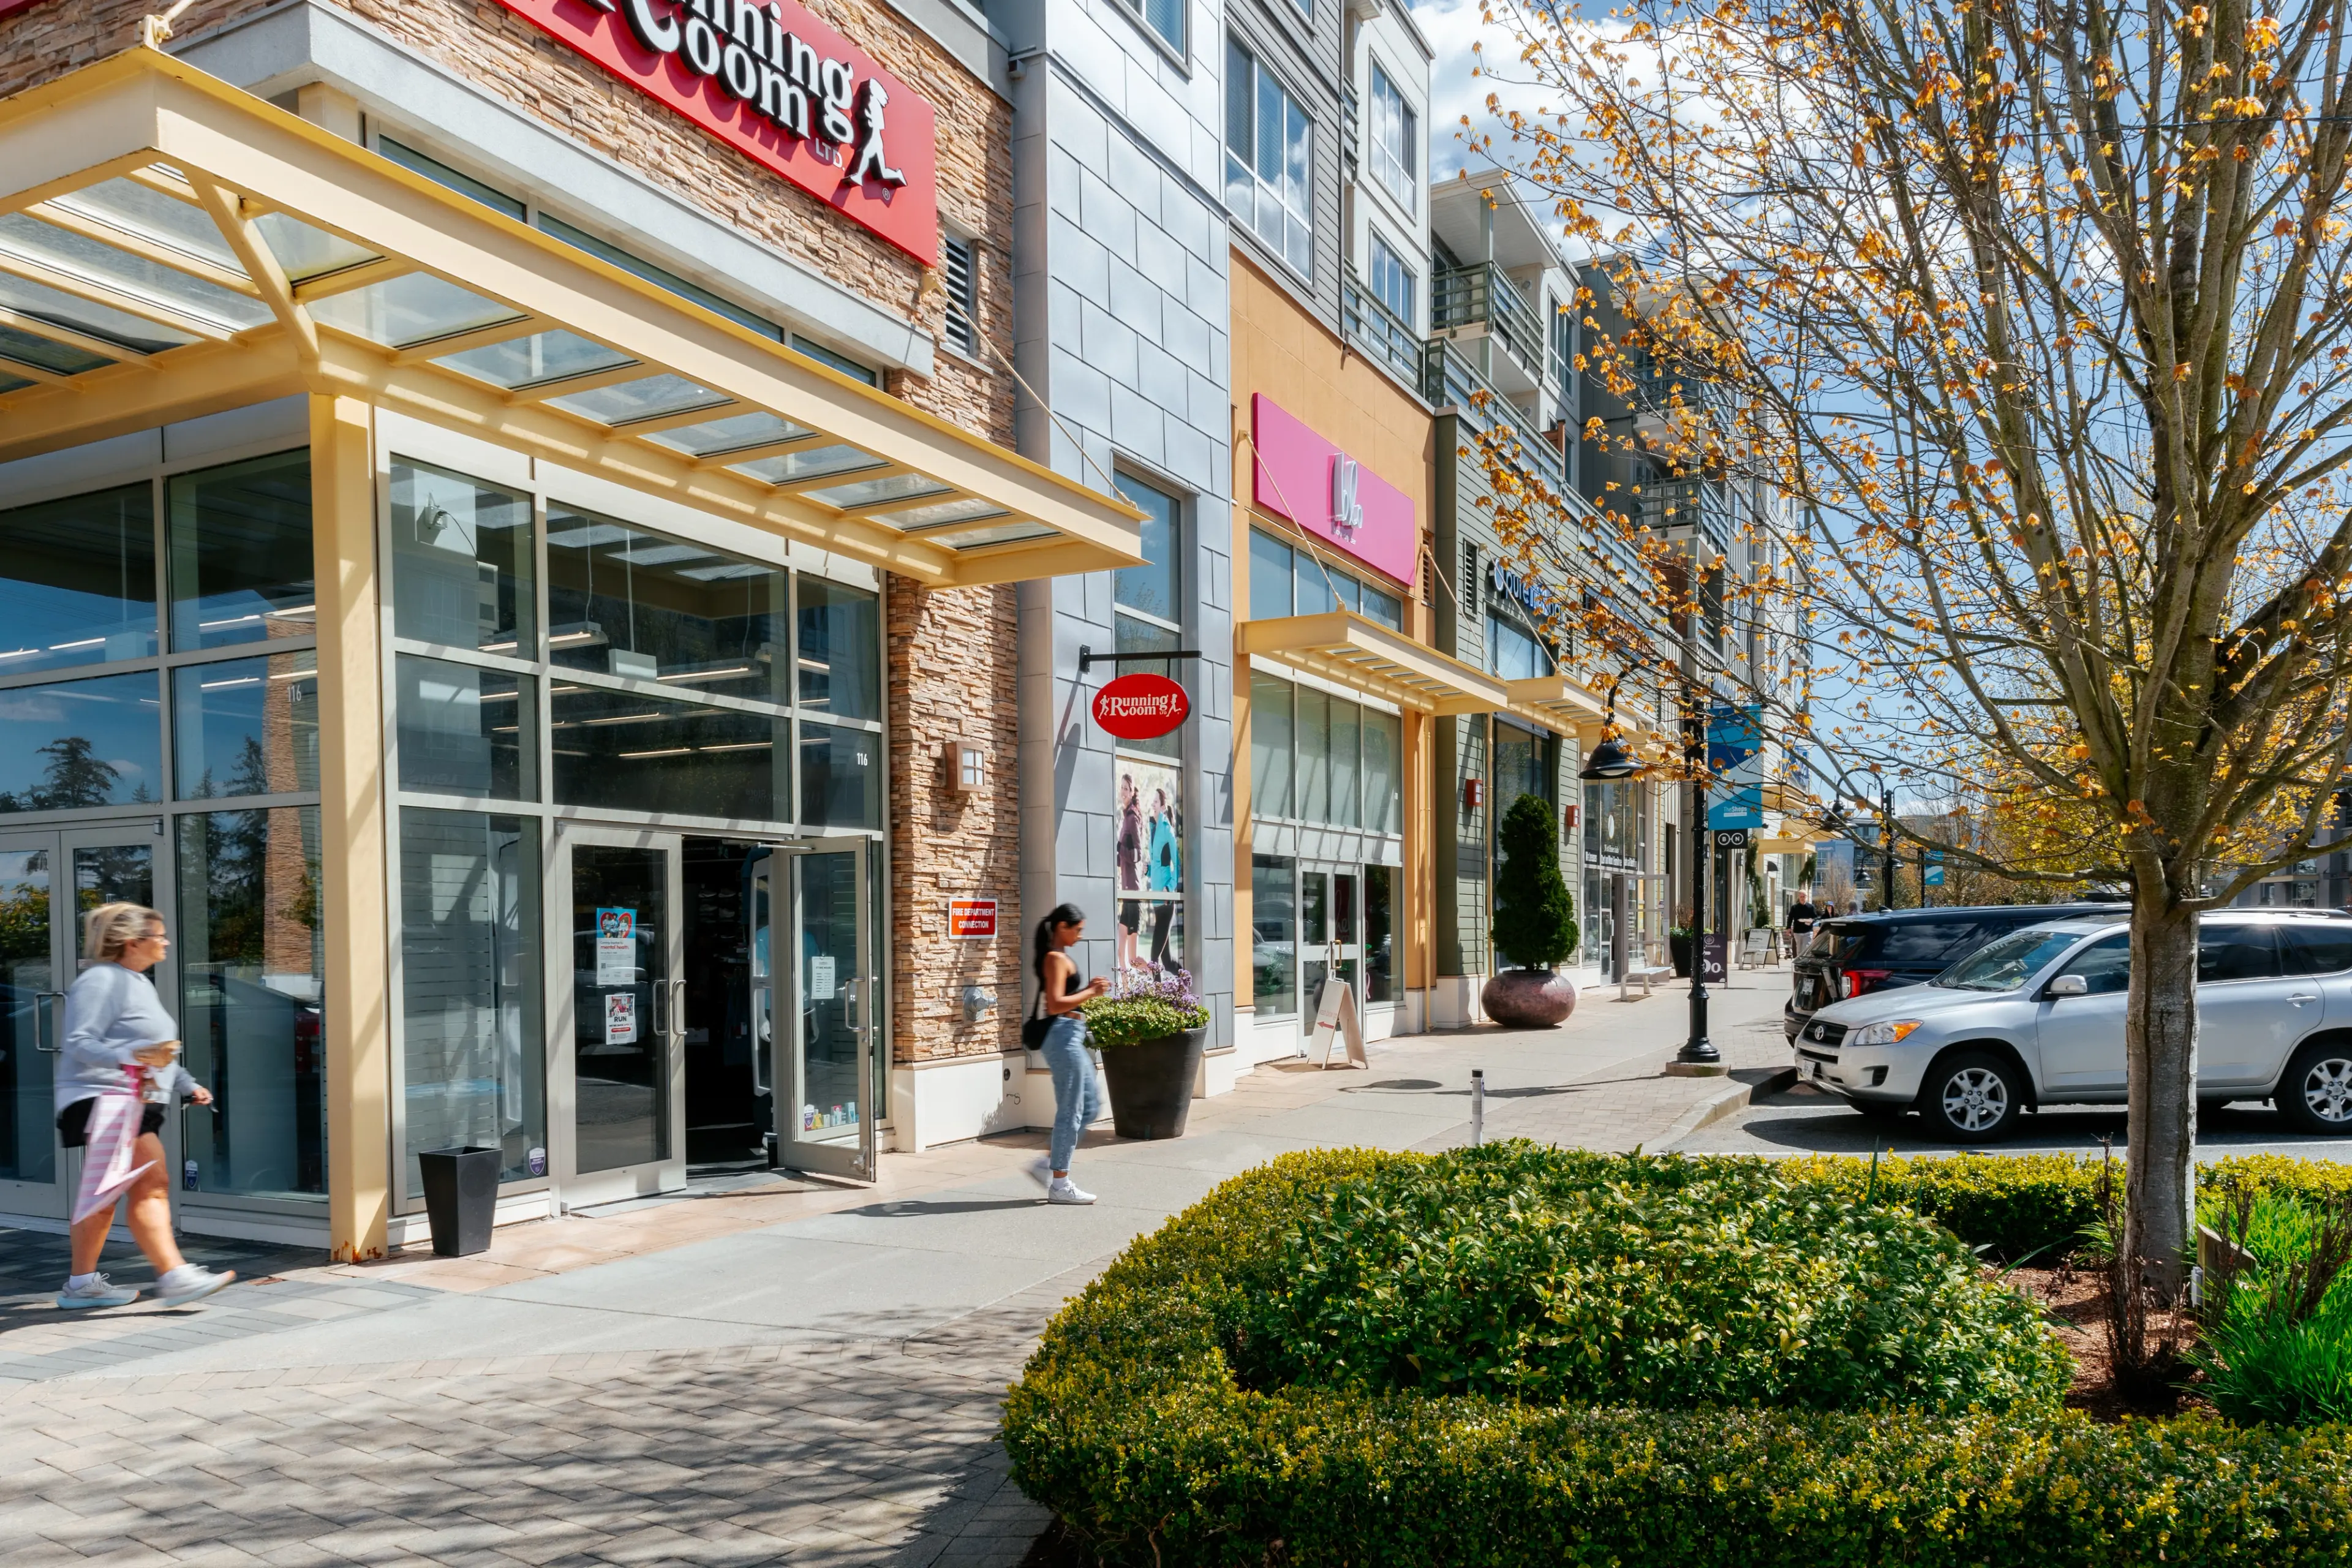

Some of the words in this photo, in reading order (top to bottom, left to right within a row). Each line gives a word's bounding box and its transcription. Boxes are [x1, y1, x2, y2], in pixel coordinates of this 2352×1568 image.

[287, 685, 301, 702] 116
[1109, 693, 1169, 717] Running
[857, 753, 867, 766] 116
[952, 908, 963, 916] FIRE
[964, 908, 994, 916] DEPARTMENT
